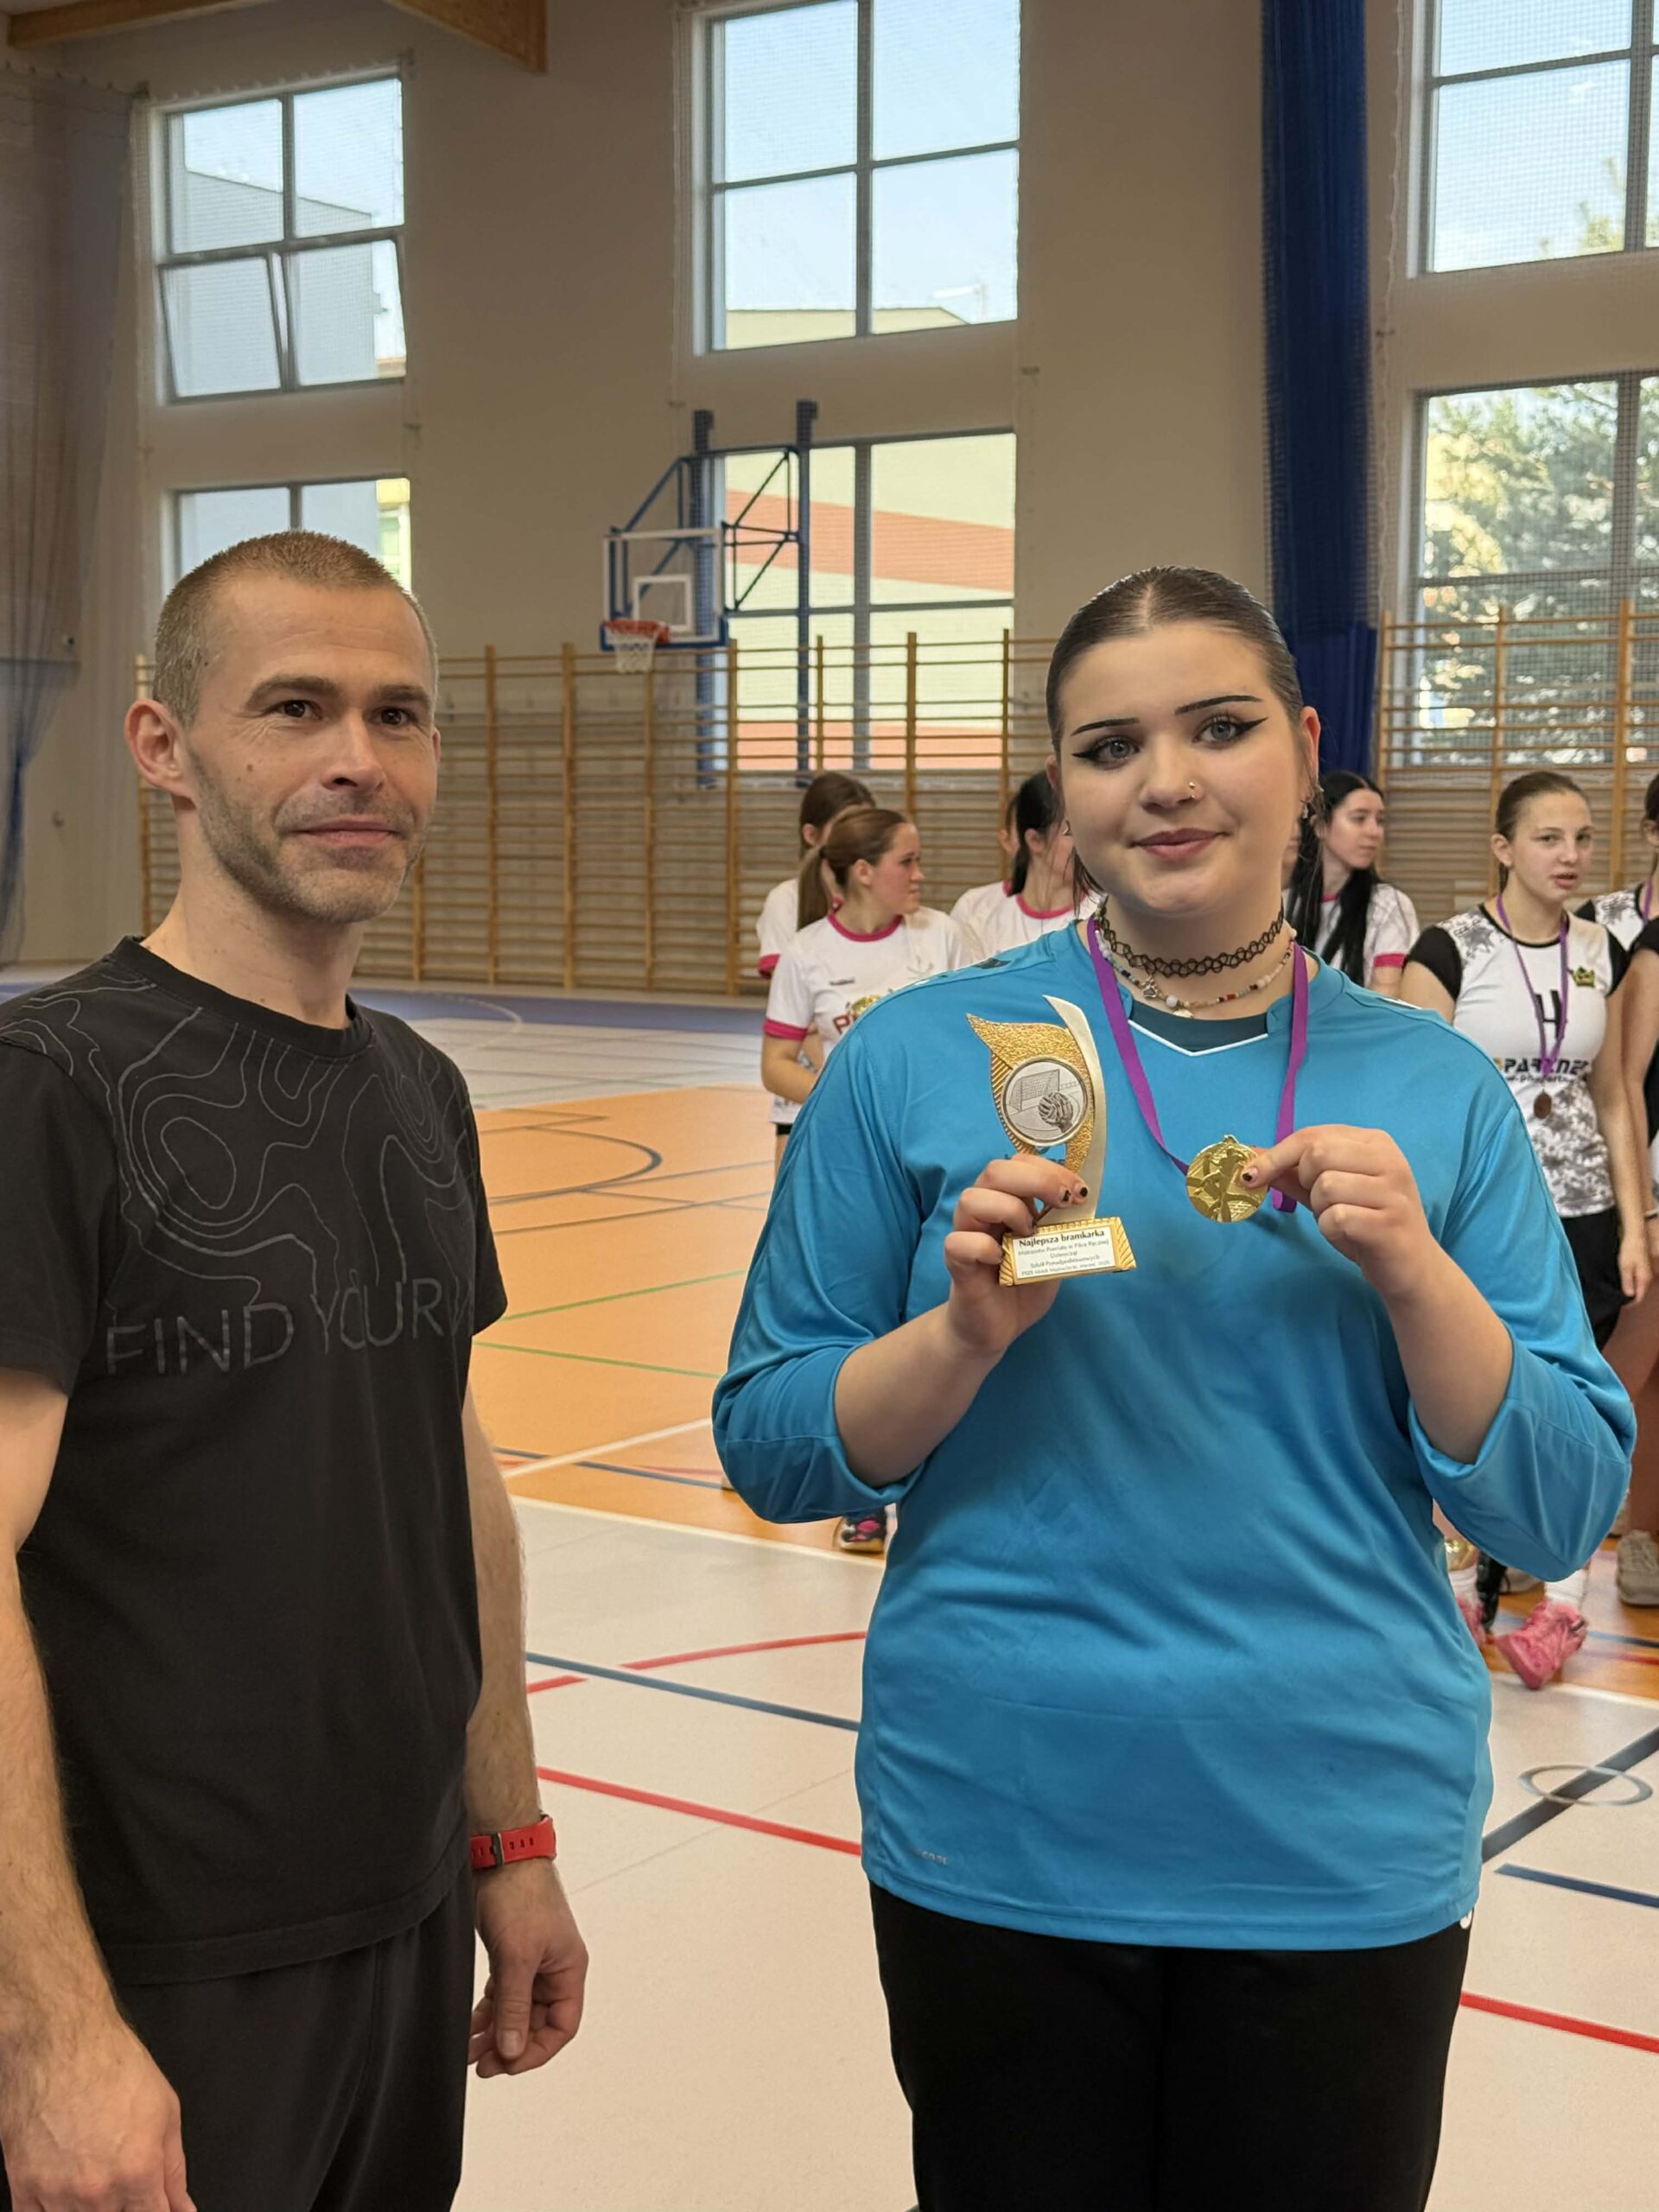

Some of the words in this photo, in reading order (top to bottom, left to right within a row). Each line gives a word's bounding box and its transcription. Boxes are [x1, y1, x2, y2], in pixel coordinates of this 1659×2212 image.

[1019, 1236, 1059, 1248] Najlepsza
[1060, 1230, 1105, 1242] bramkarka
[106, 1302, 294, 1375] FIND
[309, 1277, 445, 1355] YOUR
